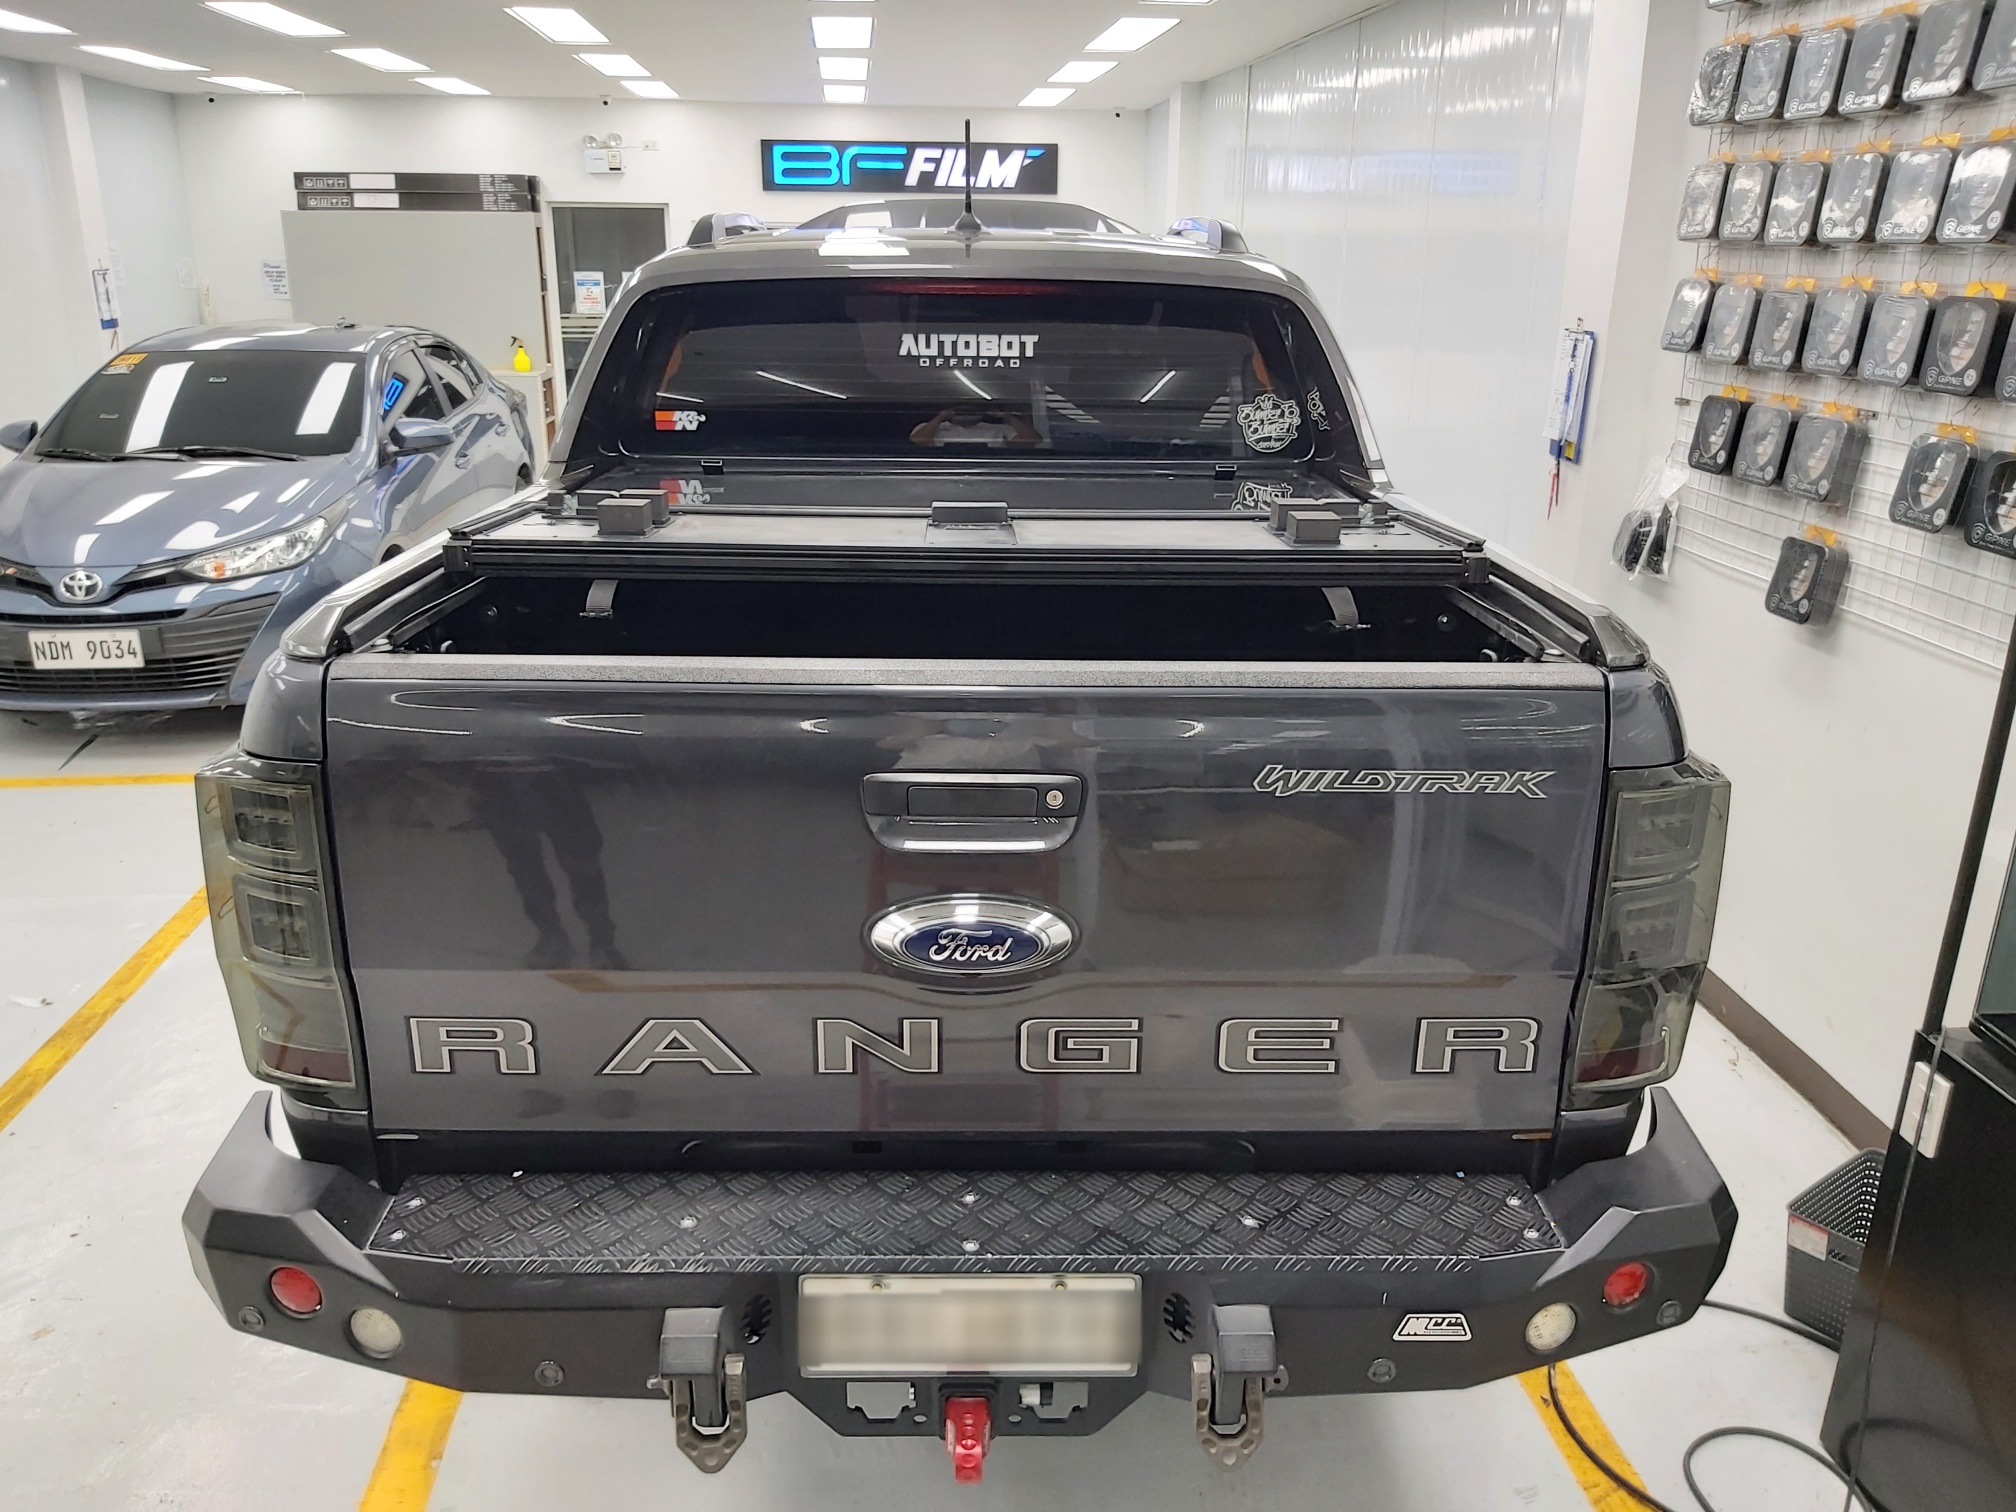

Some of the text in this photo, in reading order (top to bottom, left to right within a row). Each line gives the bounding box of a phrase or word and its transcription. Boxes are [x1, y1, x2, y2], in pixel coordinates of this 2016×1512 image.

[1798, 102, 1819, 111] GPNE
[772, 144, 1027, 188] BF FILM
[1893, 226, 1917, 235] GPNE
[1955, 223, 1984, 234] GPNE
[899, 333, 1040, 358] AUTOBOT
[919, 358, 1020, 368] OFFROAD
[1817, 357, 1838, 367] GPNE
[1874, 368, 1897, 378] GPNE
[1938, 375, 1963, 386] GPNE
[1796, 482, 1817, 493] GPNE
[1906, 509, 1931, 522] GPNE
[1984, 532, 2012, 547] GPNE
[34, 639, 138, 661] NDM 9034
[1252, 764, 1557, 799] WILDTRAK
[928, 927, 1015, 962] Ford
[408, 1016, 1542, 1075] RANGER
